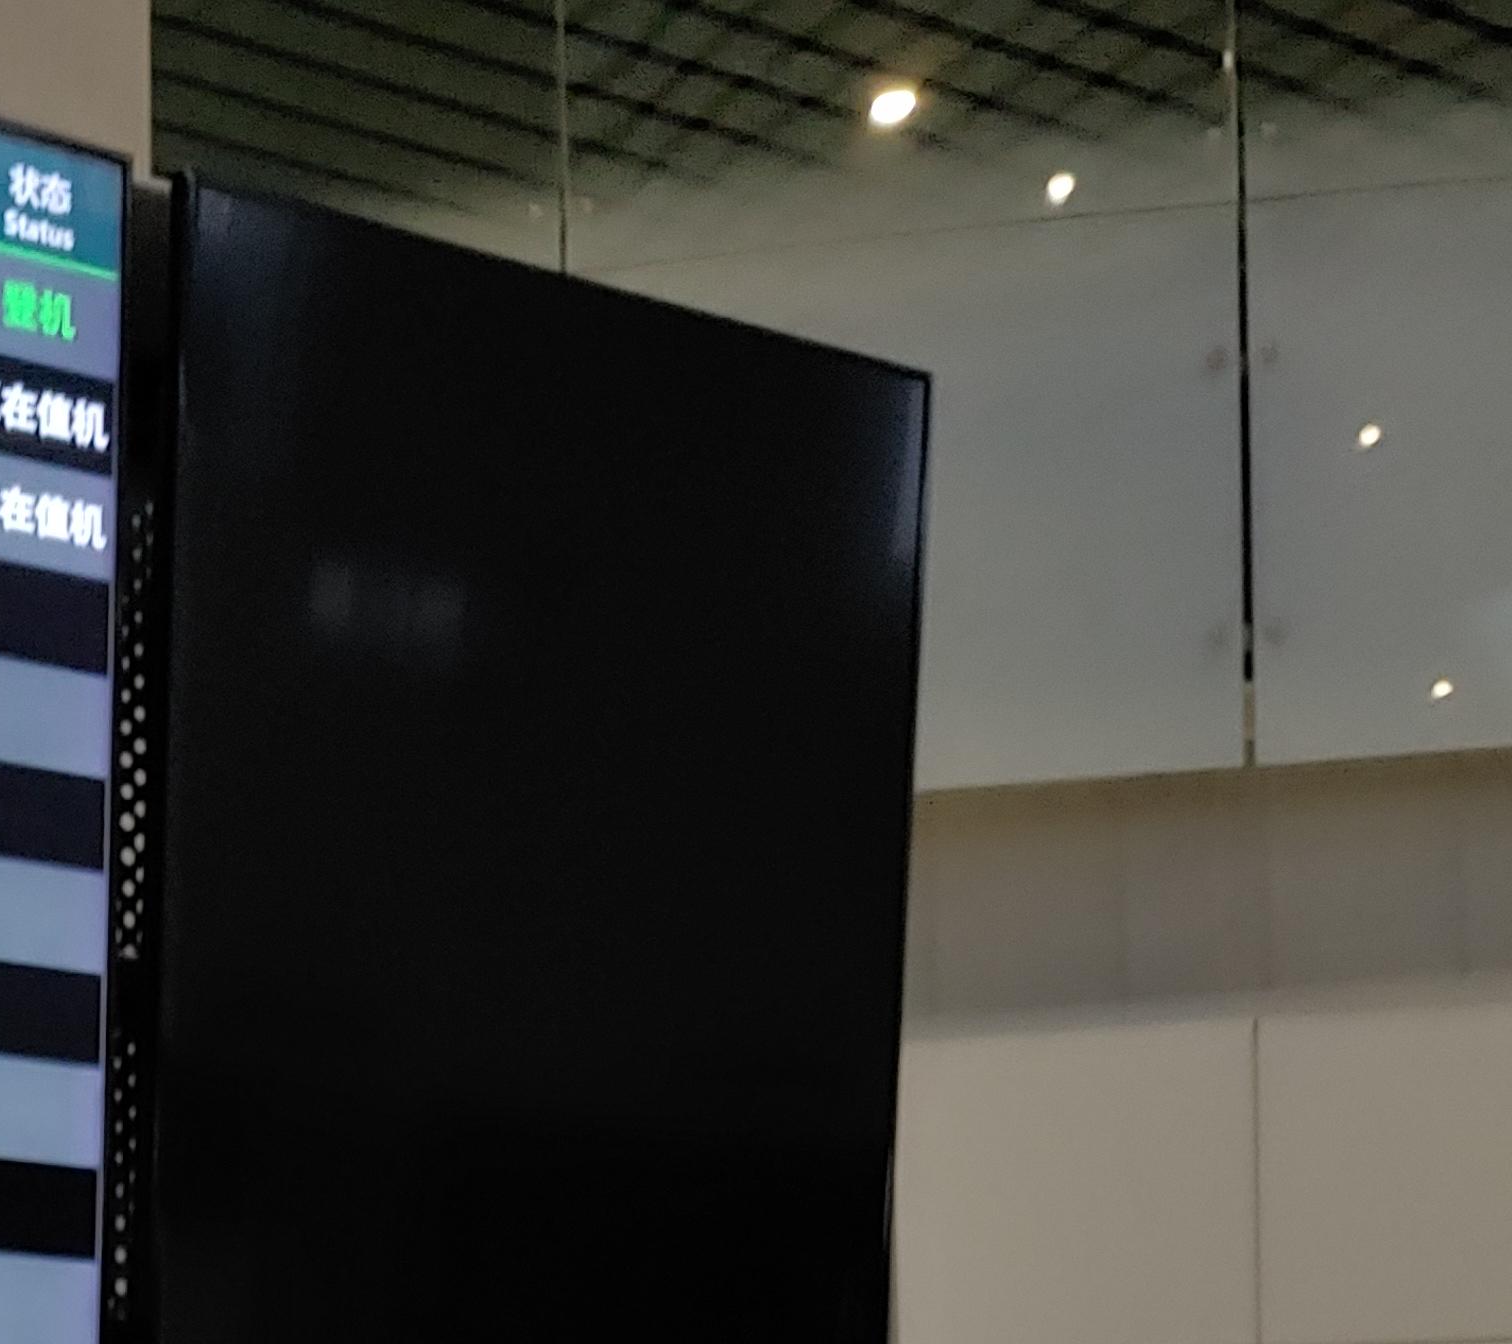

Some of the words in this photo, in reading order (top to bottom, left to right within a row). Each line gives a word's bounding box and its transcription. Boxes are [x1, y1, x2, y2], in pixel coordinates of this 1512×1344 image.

[9, 161, 72, 216] 状态
[3, 208, 74, 253] Status
[2, 279, 76, 343] 登机
